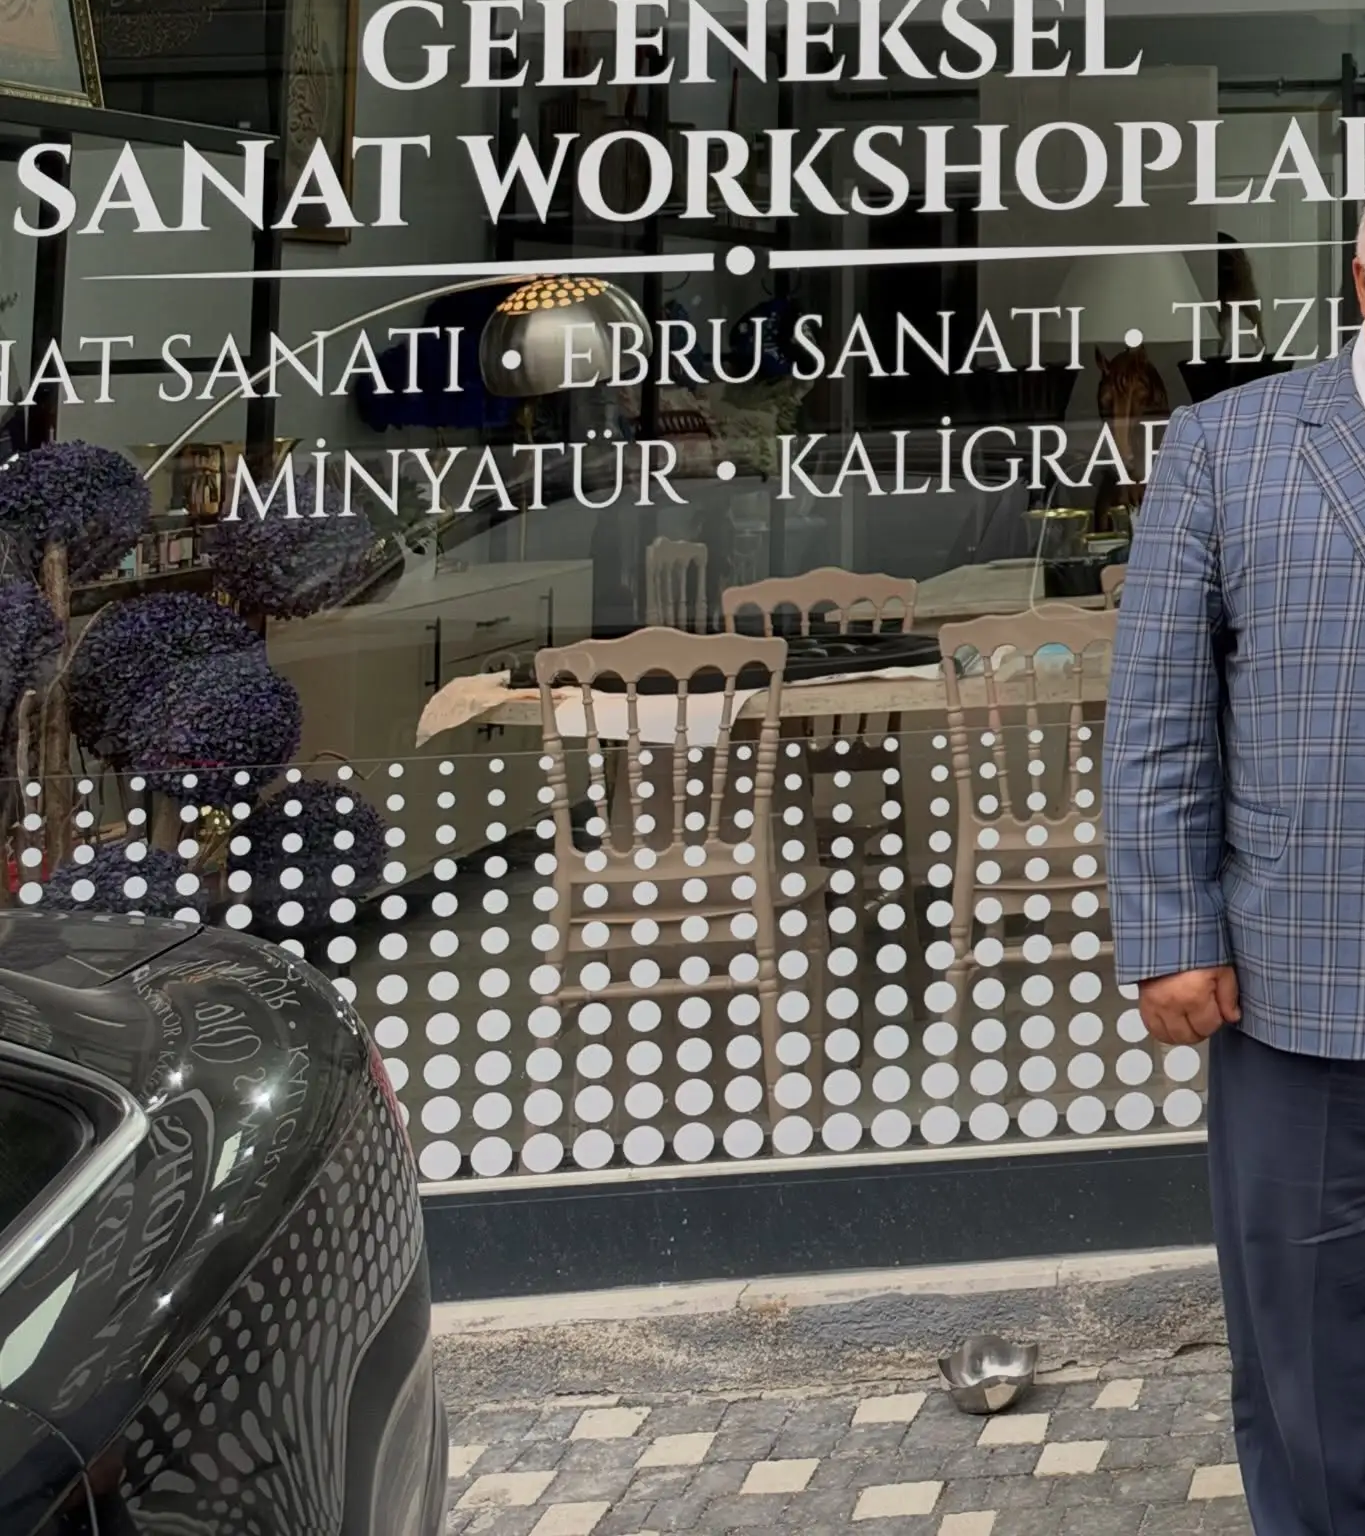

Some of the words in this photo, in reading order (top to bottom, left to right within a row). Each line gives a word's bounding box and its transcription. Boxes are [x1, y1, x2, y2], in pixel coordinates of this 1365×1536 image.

[13, 134, 431, 238] SANAT
[0, 335, 134, 406] AT
[157, 326, 465, 403] SANATI
[557, 316, 768, 389] EBRU
[792, 306, 1085, 381] SANATI
[222, 429, 689, 522] MİNYATÜR
